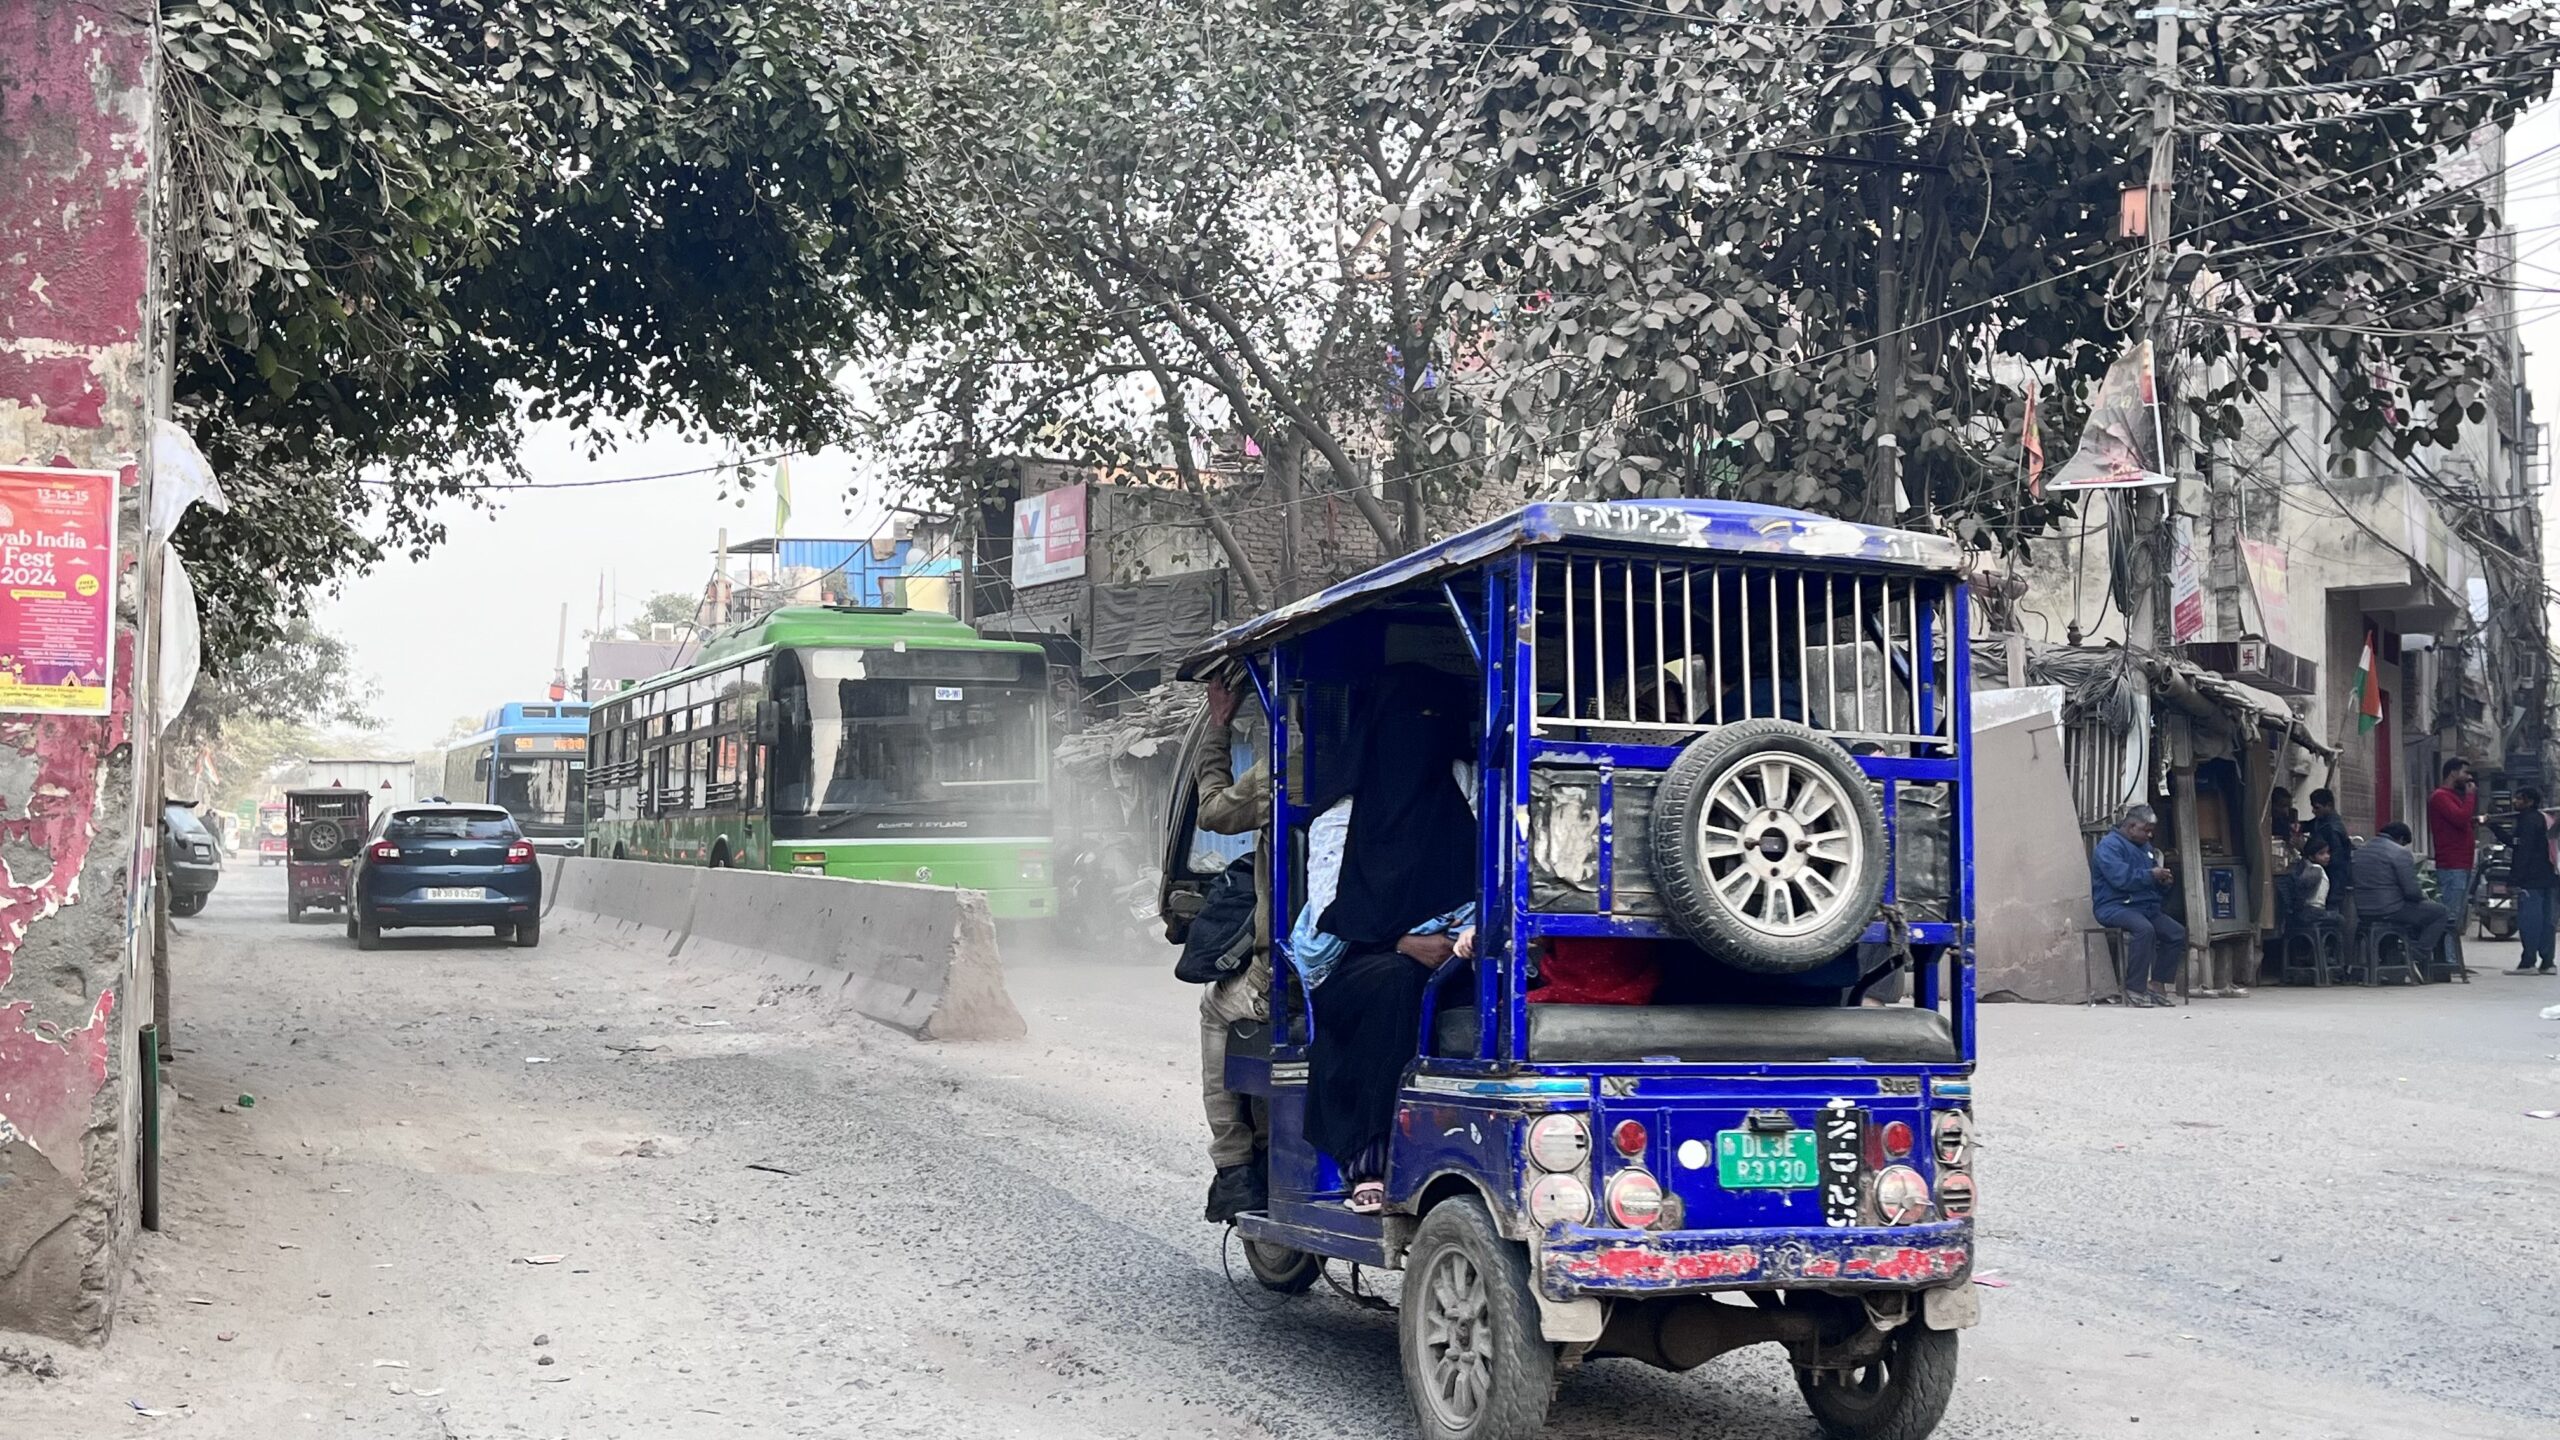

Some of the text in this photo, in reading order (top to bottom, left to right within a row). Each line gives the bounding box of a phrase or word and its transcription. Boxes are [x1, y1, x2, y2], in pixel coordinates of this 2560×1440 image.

[37, 488, 89, 502] 13-14-15
[36, 530, 87, 549] India
[4, 545, 55, 568] Fest
[0, 566, 57, 586] 2024
[1736, 1160, 1807, 1183] R3130
